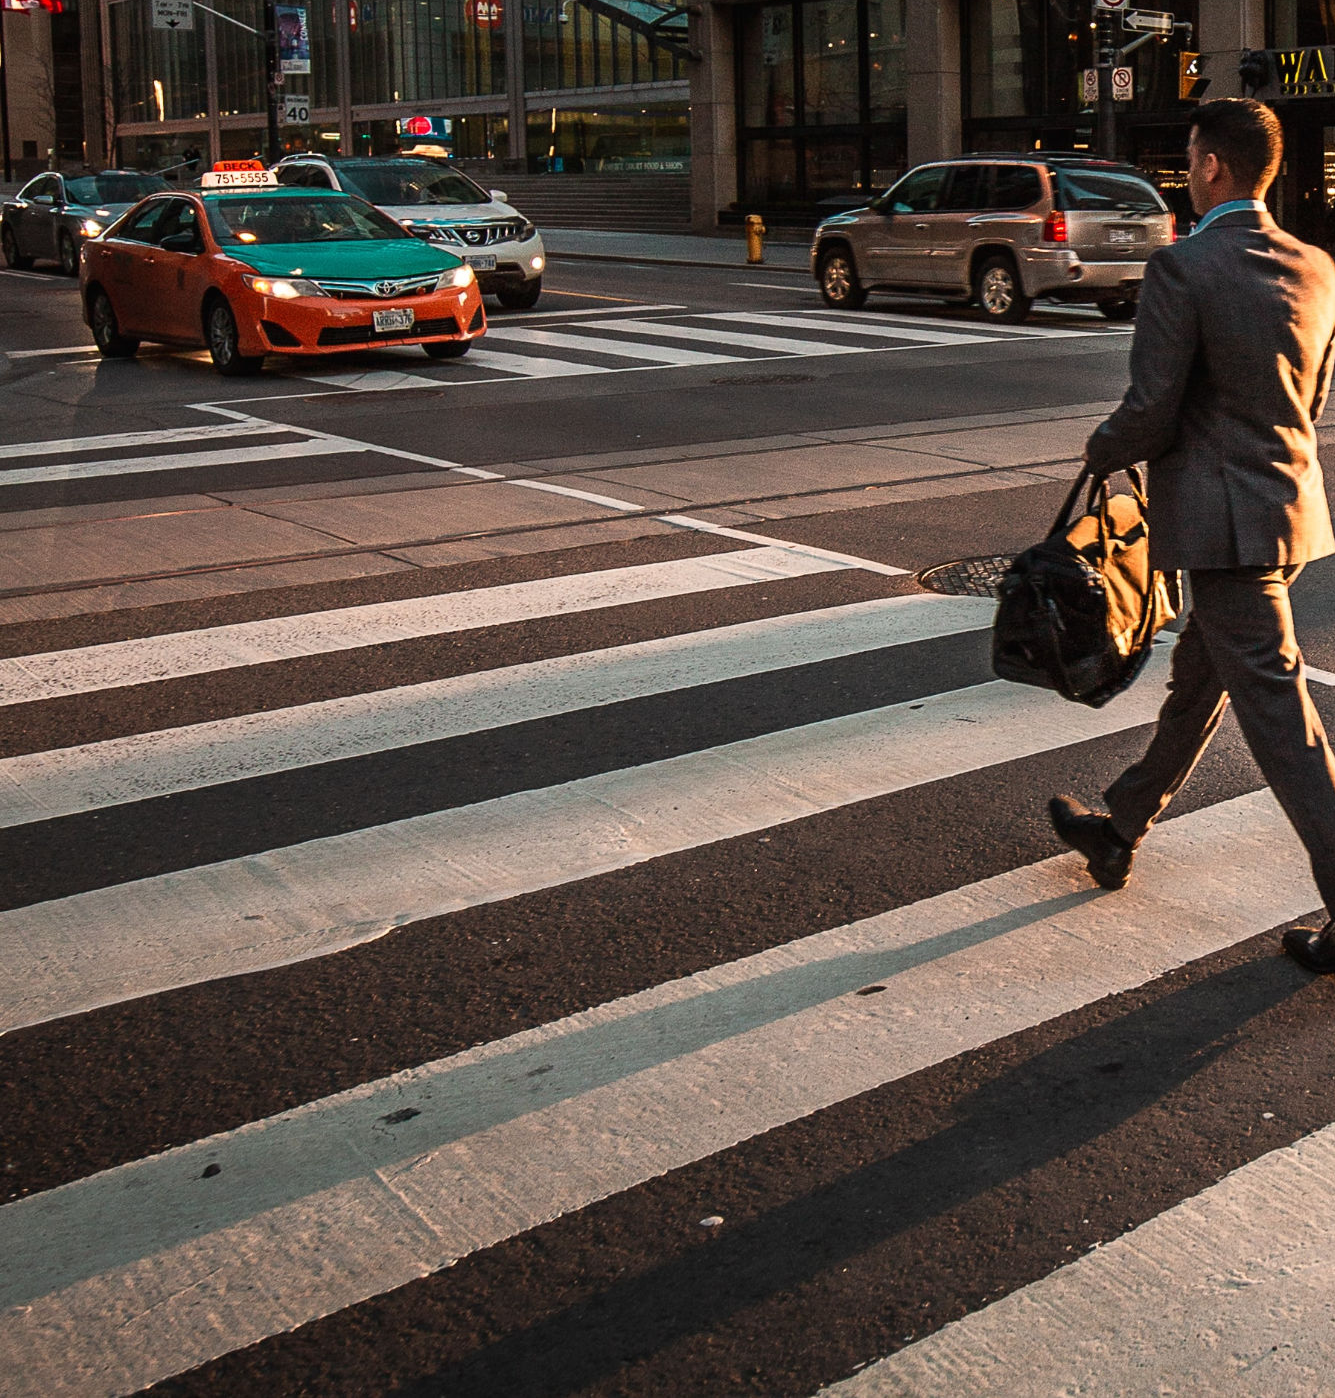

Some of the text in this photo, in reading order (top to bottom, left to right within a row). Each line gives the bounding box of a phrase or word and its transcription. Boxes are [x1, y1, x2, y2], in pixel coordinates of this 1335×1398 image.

[296, 7, 308, 41] CONNECT
[287, 106, 309, 122] 40
[223, 162, 256, 170] BECK
[215, 172, 269, 184] 751-5555
